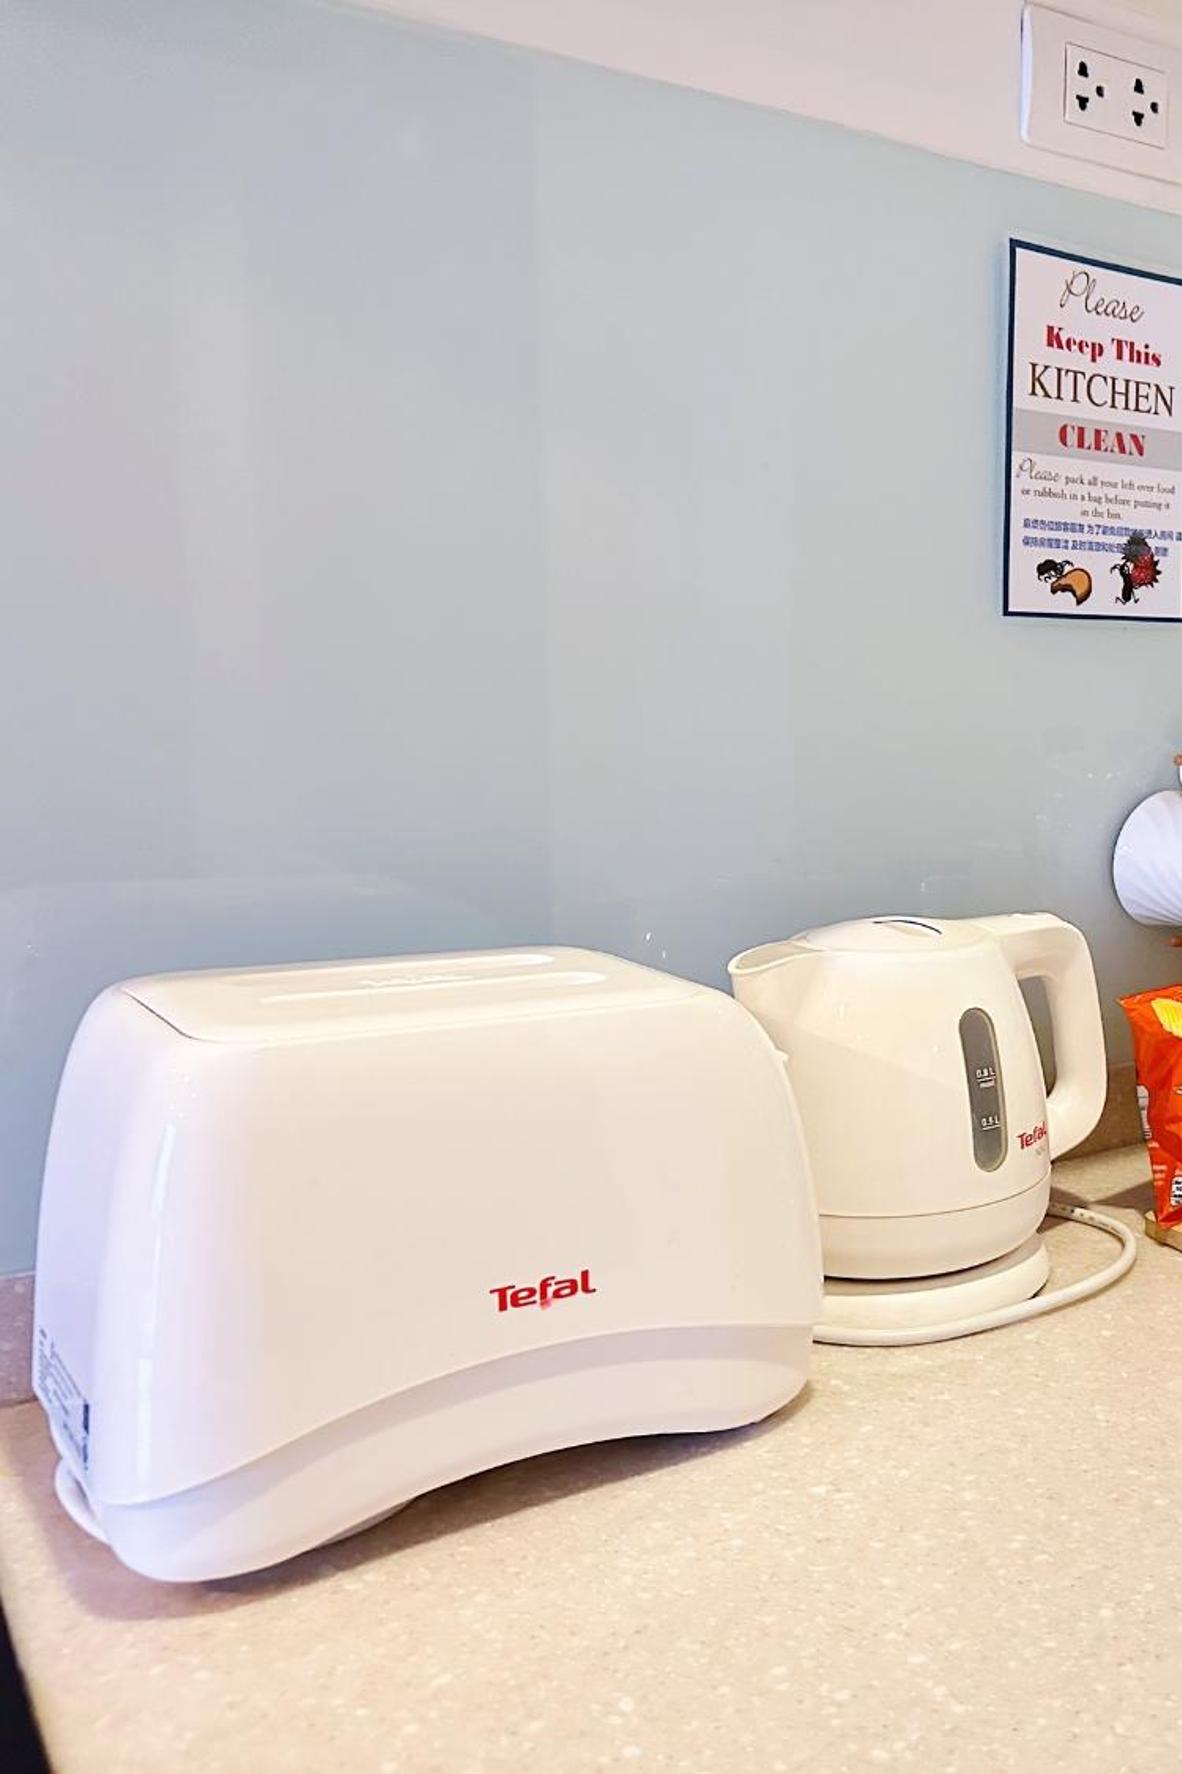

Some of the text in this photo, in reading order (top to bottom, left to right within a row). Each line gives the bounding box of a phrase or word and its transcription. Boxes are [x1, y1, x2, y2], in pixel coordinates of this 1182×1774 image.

[1059, 270, 1145, 323] Please
[1046, 324, 1162, 368] Keep This
[1028, 361, 1176, 417] KITCHEN
[1058, 423, 1146, 457] CLEAN
[1016, 457, 1175, 495] Please pack all your left over food
[1021, 488, 1031, 496] or
[1033, 487, 1068, 501] rubbish
[1069, 492, 1078, 501] in
[1088, 491, 1102, 504] bag
[1104, 493, 1131, 507] before
[1134, 498, 1162, 511] putting
[1164, 500, 1170, 509] it
[1092, 508, 1104, 519] the
[1017, 1121, 1047, 1149] Tefal
[489, 1269, 597, 1312] Tefal
